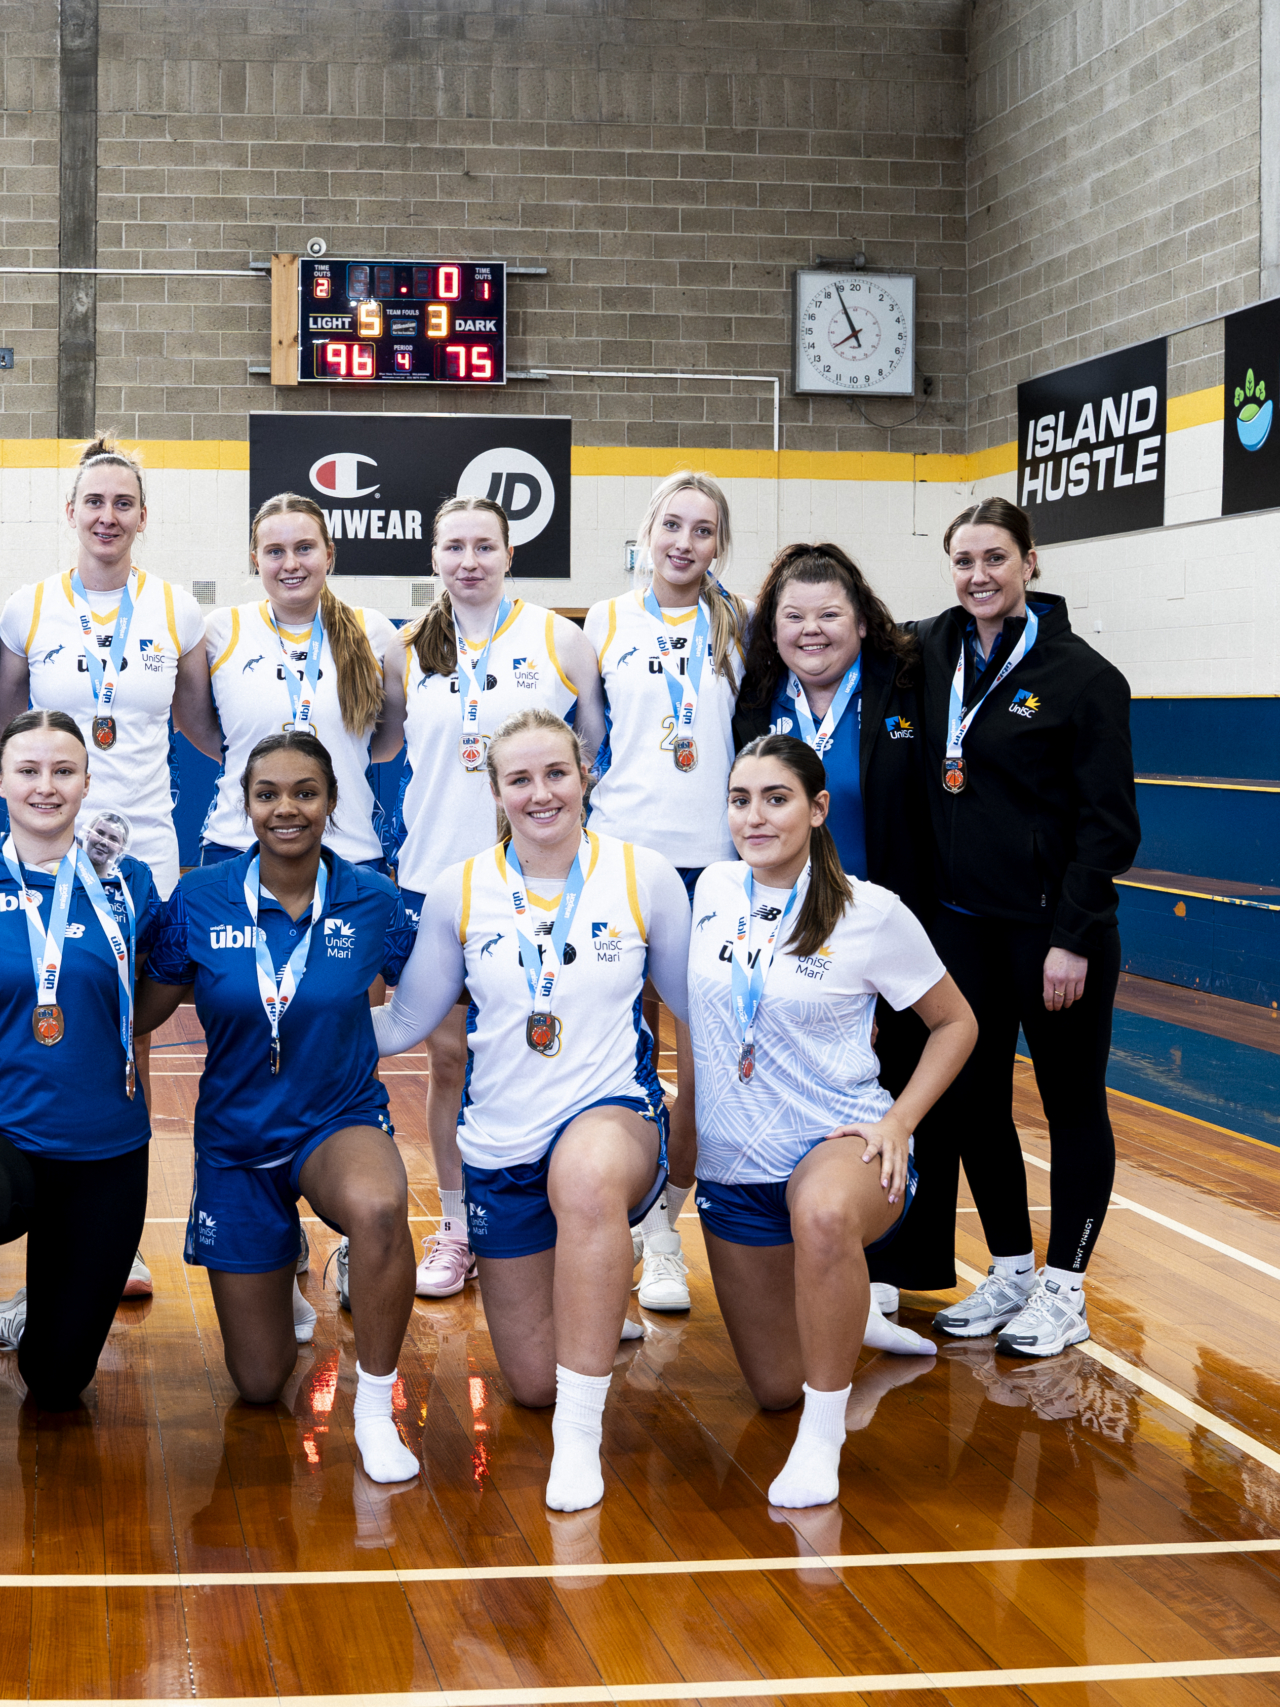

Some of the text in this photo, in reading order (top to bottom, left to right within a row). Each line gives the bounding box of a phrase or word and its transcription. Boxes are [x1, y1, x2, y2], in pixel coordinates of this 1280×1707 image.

[315, 279, 329, 297] 2
[483, 282, 489, 299] 1
[308, 317, 352, 329] LIGHT
[359, 303, 381, 336] 5
[426, 305, 448, 337] 3
[455, 319, 497, 332] DARK
[895, 316, 900, 324] 4
[326, 344, 373, 376] 96
[397, 353, 410, 370] 4
[445, 345, 492, 378] 75
[850, 376, 858, 384] 10
[1026, 385, 1158, 460] ISLAND
[1021, 435, 1161, 507] HUSTLE
[485, 472, 542, 521] JD
[320, 508, 423, 540] MWEAR
[79, 615, 92, 631] ubl
[656, 636, 670, 652] ubl
[141, 653, 165, 664] UniSC
[144, 662, 163, 673] Mari
[514, 671, 539, 681] UniSC
[516, 680, 537, 689] Mari
[103, 687, 114, 703] ubl
[300, 705, 311, 721] ubl
[468, 704, 478, 721] ubl
[683, 707, 694, 725] ubl
[1008, 703, 1036, 718] UniSC
[890, 729, 914, 739] UniSC
[512, 891, 525, 910] ubl
[110, 936, 125, 955] ubl
[210, 925, 253, 950] ubl
[325, 937, 355, 948] UniSC
[593, 940, 623, 951] UniSC
[327, 948, 351, 959] Mari
[597, 952, 620, 962] Mari
[797, 953, 832, 971] UniSC
[45, 969, 57, 990] ubl
[795, 964, 825, 981] Mari
[542, 976, 554, 997] ubl
[471, 1218, 489, 1227] UniSC
[472, 1226, 488, 1235] Mari
[199, 1226, 217, 1238] UniSC
[199, 1235, 215, 1246] Mari
[1072, 1218, 1094, 1269] LORNA JANE
